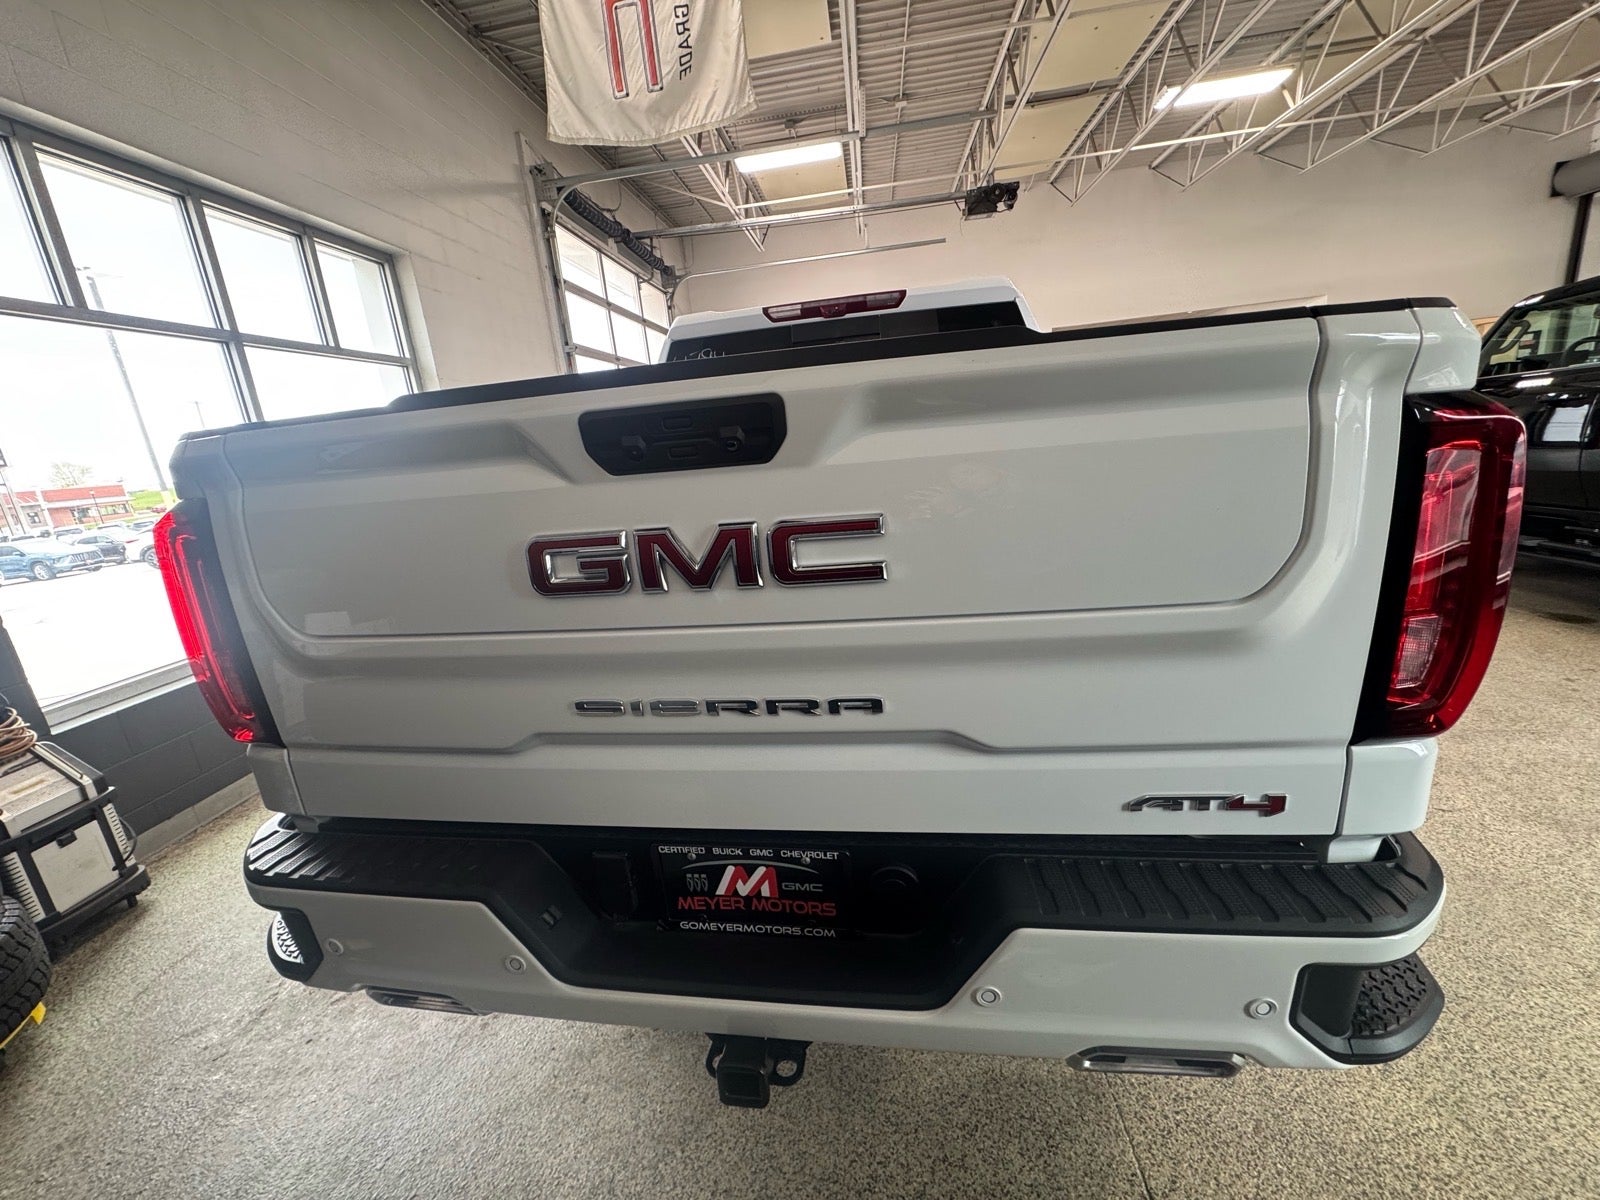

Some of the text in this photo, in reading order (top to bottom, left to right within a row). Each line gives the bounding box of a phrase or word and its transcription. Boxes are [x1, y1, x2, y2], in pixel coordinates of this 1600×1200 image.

[525, 512, 889, 597] GMC
[573, 697, 885, 717] SIERRA
[1121, 793, 1288, 817] AT4
[658, 845, 839, 860] CERTIFIED BUICK GMC CHEVROLET
[781, 882, 823, 892] GMC
[677, 896, 837, 917] MEYER MOTORS
[679, 921, 836, 938] GOMEYERMOTORS.COM
